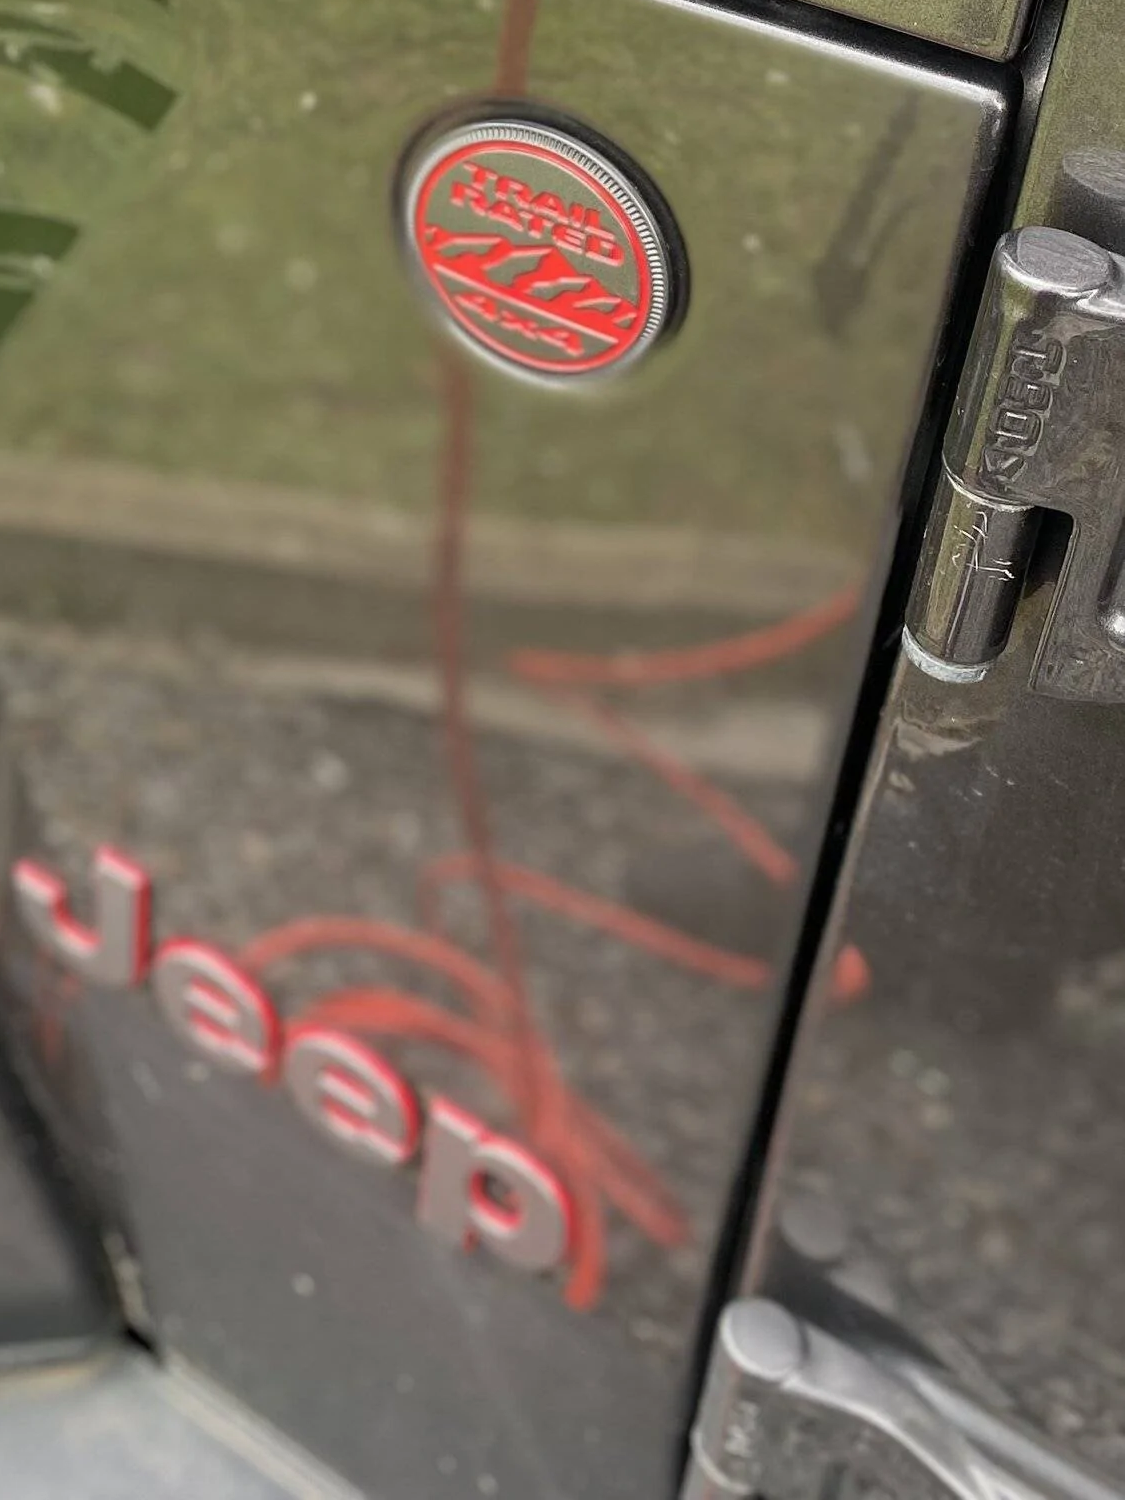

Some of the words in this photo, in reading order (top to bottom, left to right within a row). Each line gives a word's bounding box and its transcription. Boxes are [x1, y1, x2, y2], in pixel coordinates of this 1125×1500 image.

[450, 181, 623, 267] RATED
[463, 161, 616, 241] TRAIL
[13, 846, 577, 1272] Jeep
